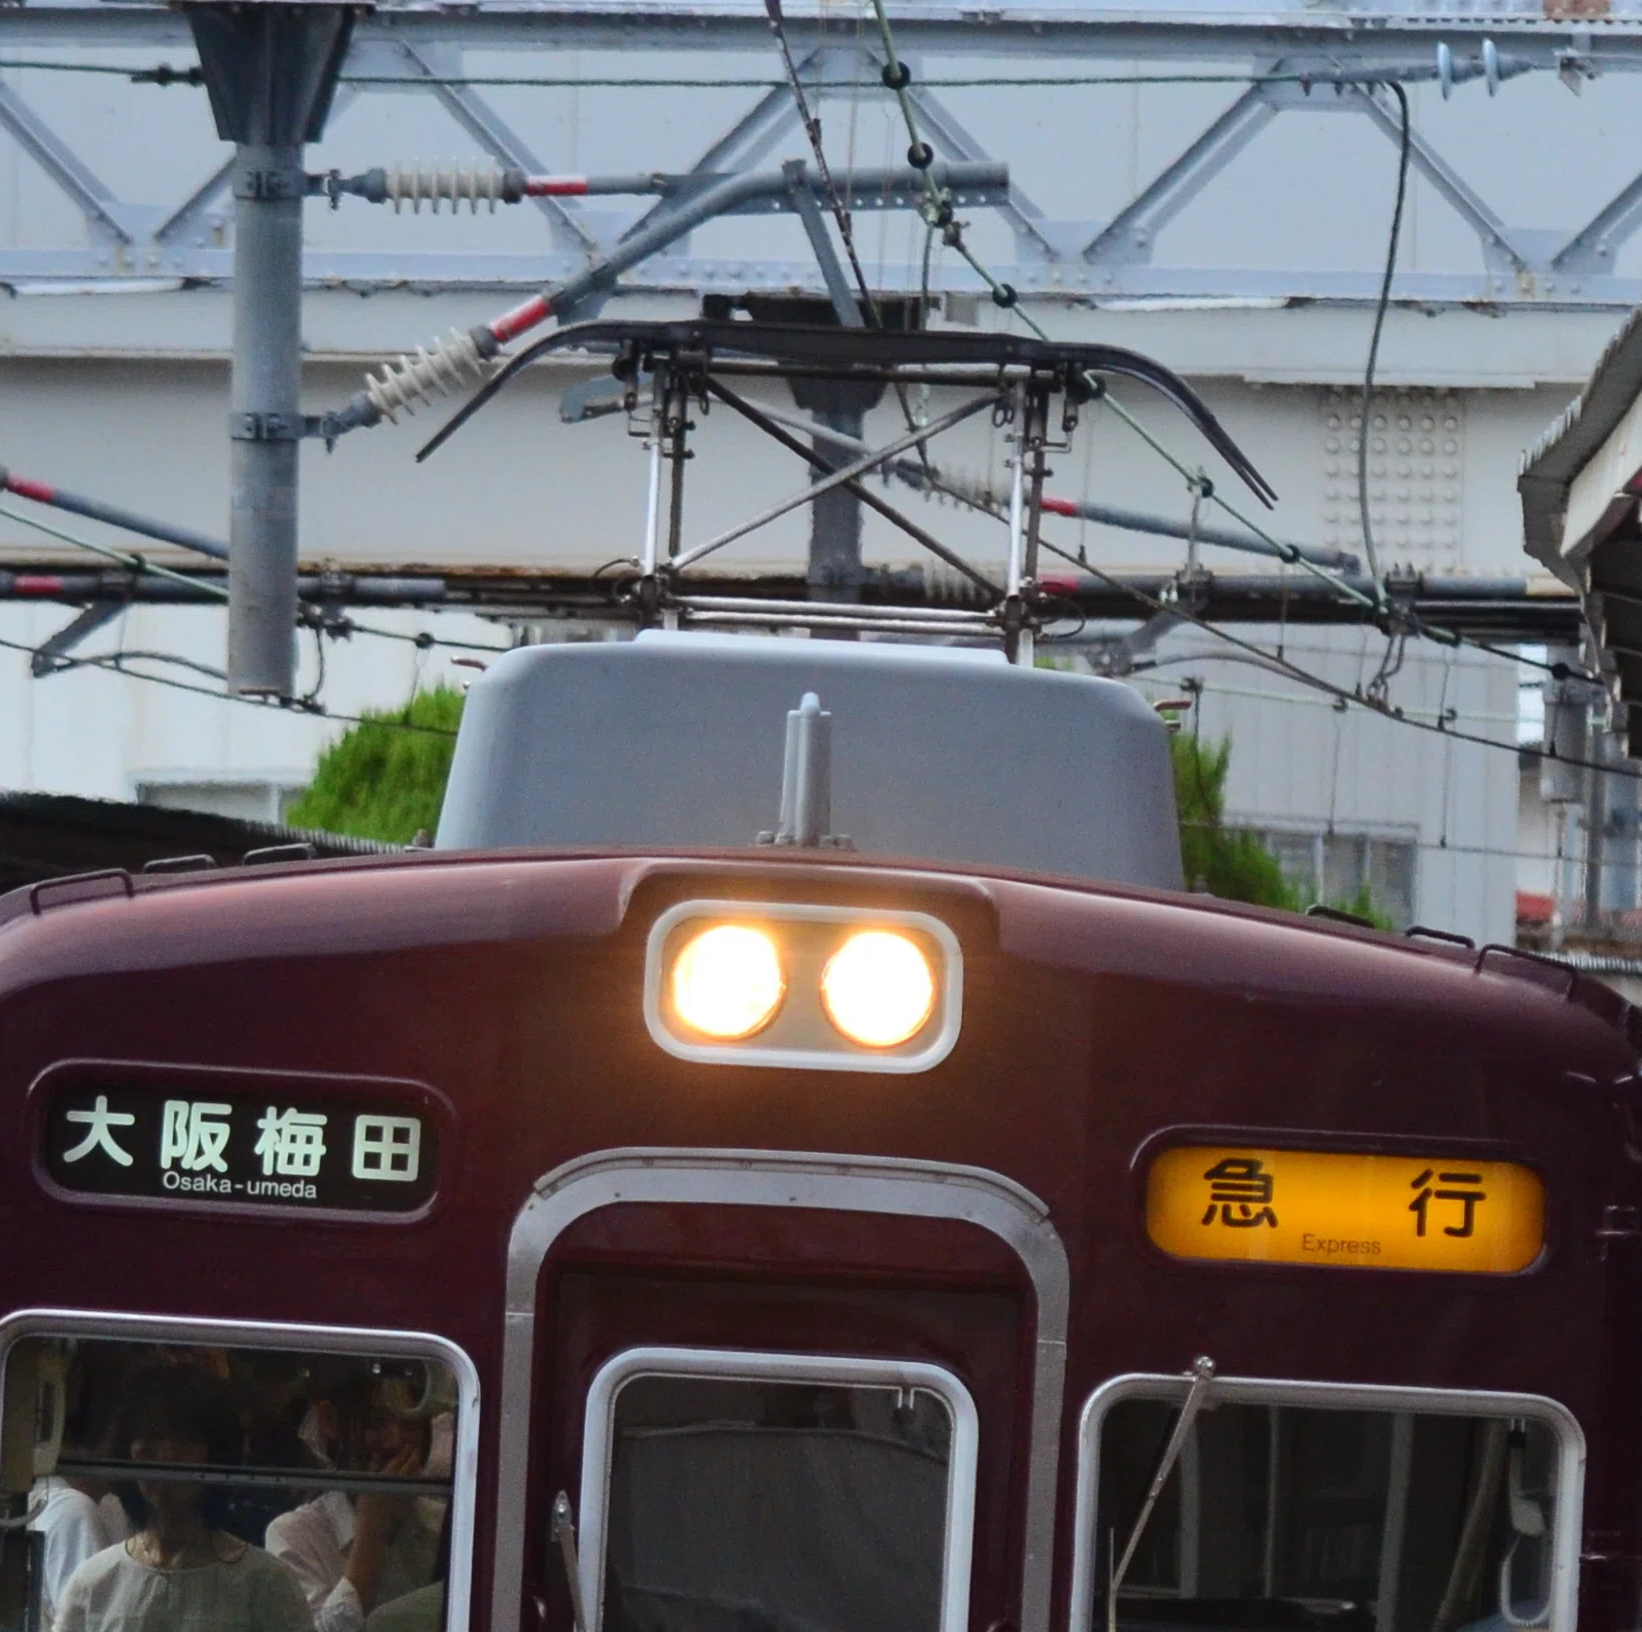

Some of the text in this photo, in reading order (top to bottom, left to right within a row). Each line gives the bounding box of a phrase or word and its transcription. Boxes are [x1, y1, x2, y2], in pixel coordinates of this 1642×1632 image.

[63, 1094, 422, 1183] 大阪梅田
[162, 1171, 317, 1200] Osaka-umeda
[1202, 1157, 1487, 1238] 急行
[1302, 1233, 1382, 1257] Express
